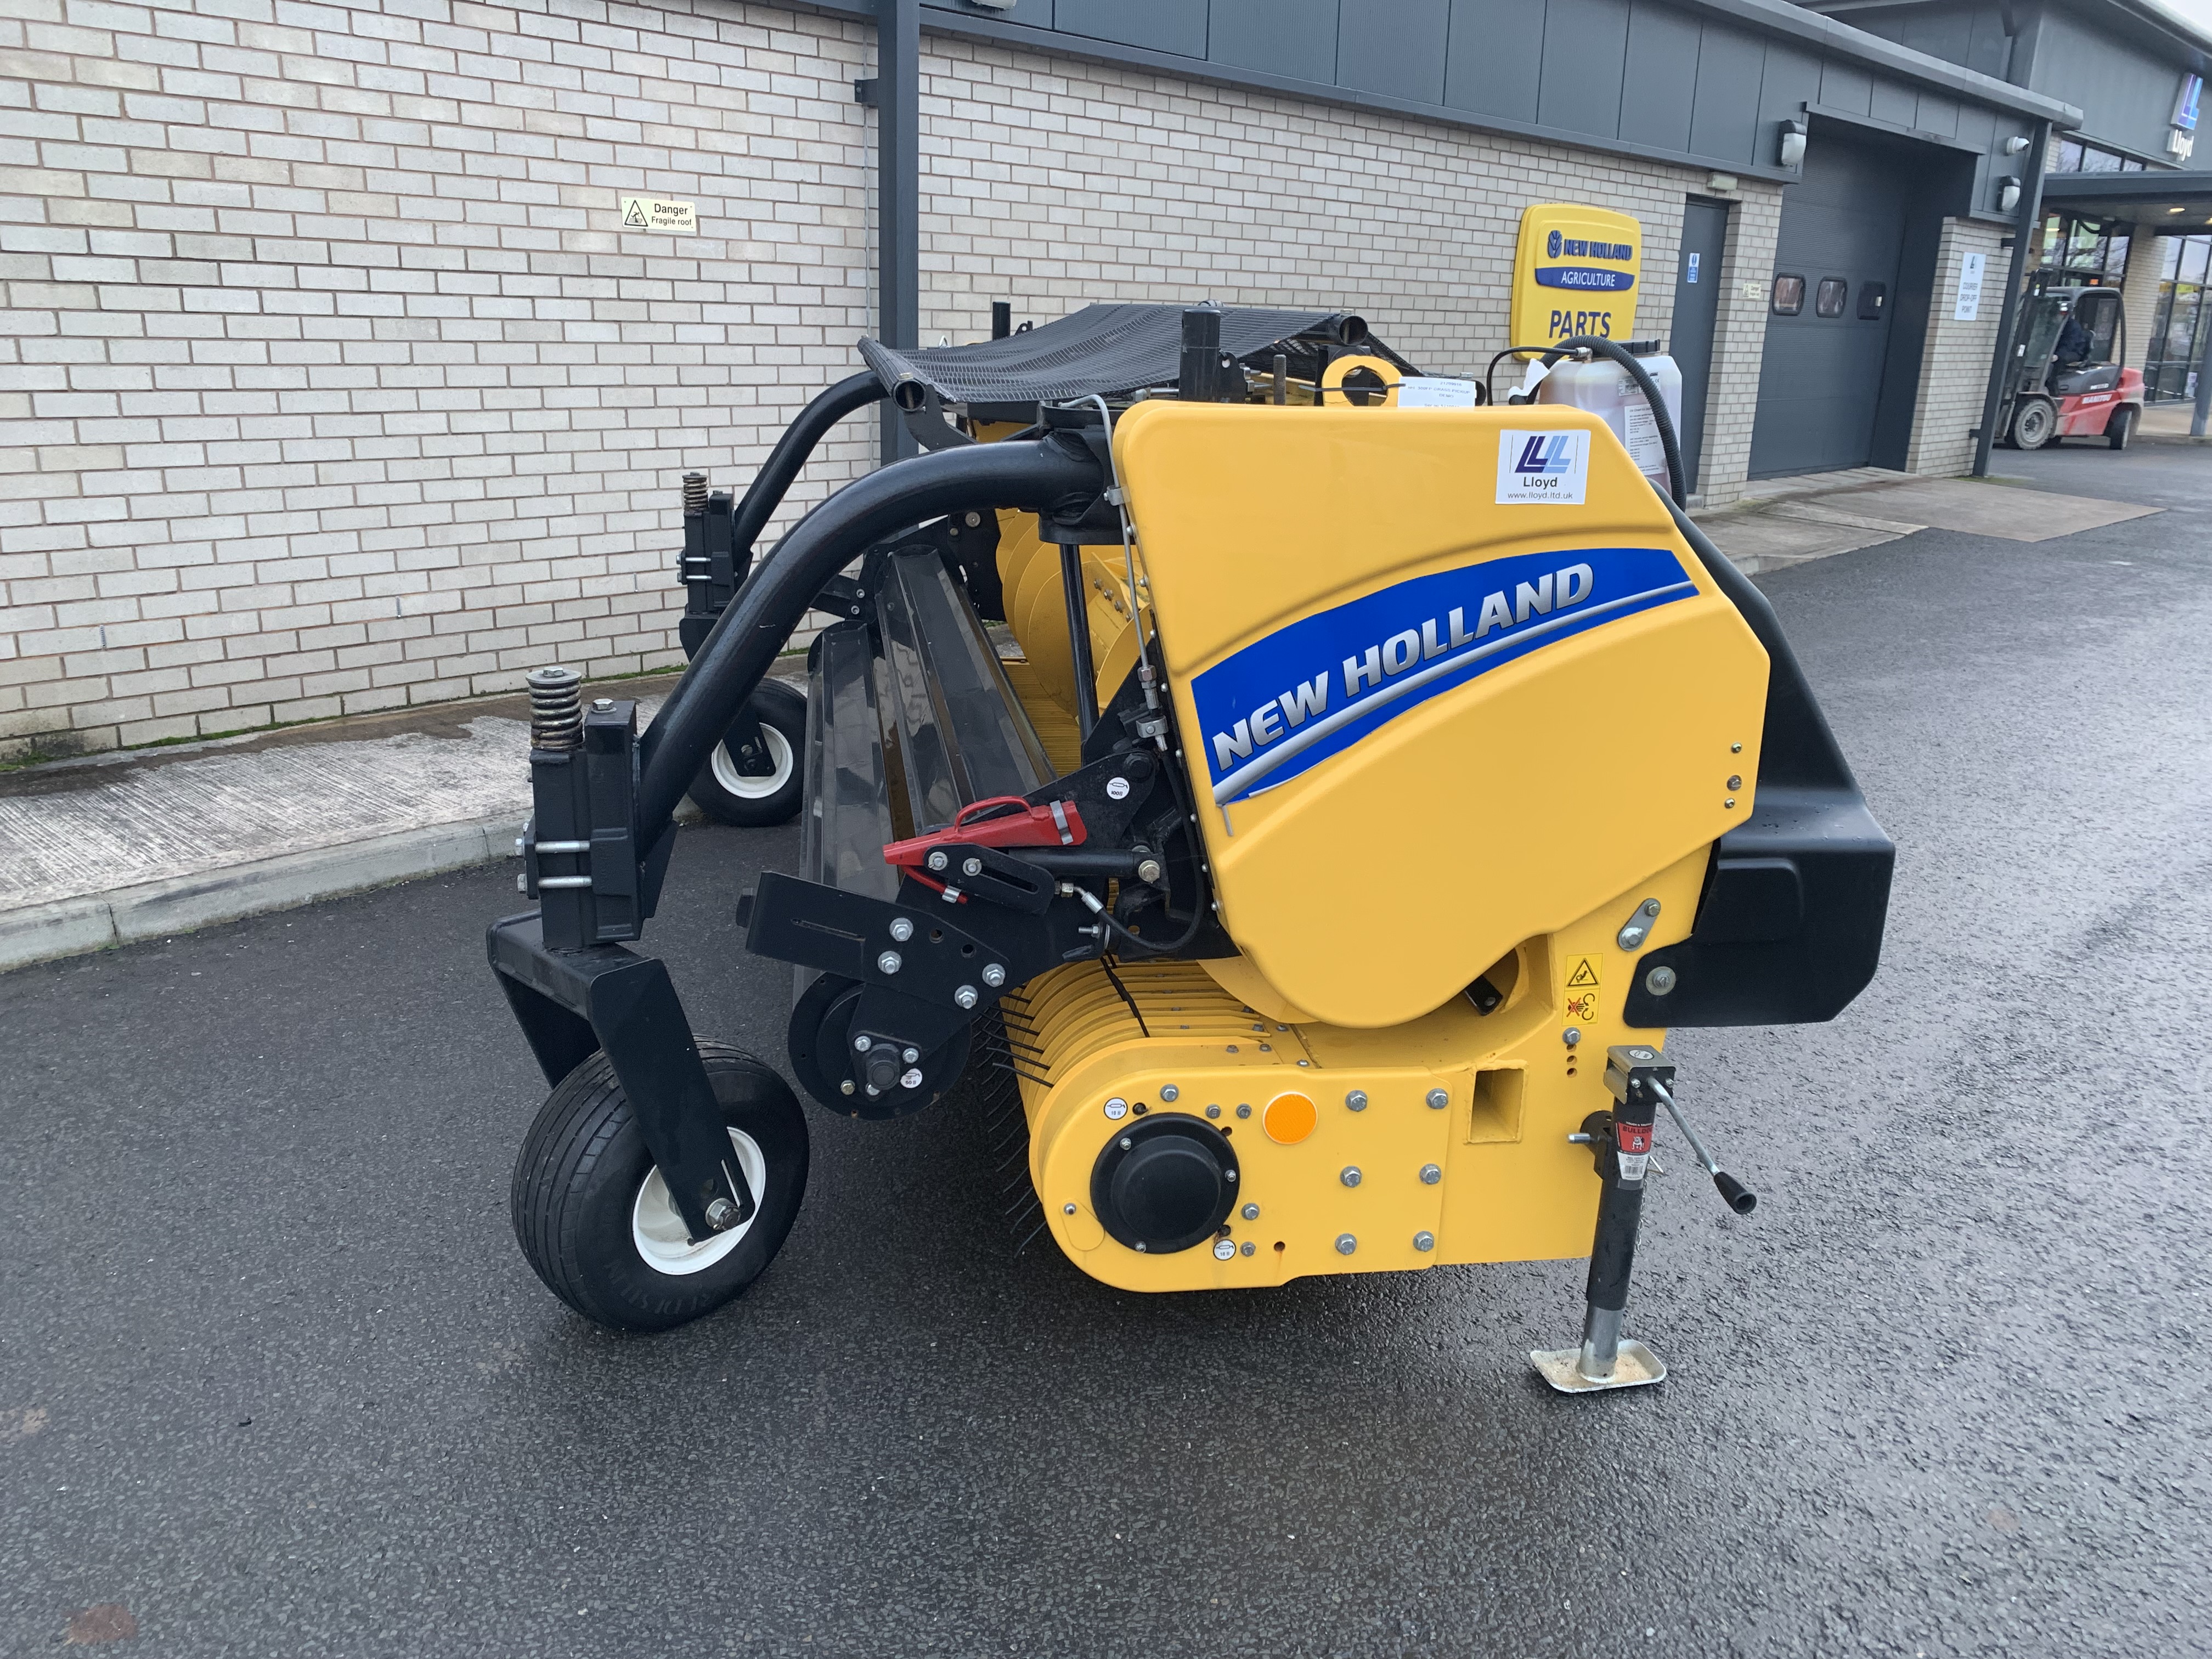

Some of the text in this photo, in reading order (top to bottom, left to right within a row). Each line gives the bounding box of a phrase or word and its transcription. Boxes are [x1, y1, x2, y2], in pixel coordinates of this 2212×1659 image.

[2172, 129, 2194, 161] Lloyd
[654, 204, 688, 216] Danger
[651, 216, 675, 226] Fragile
[1564, 239, 1633, 261] NEW HOLLAND
[1561, 271, 1616, 287] AGRICULTURE
[1549, 310, 1612, 339] PARTS
[1523, 476, 1558, 490] Lloyd
[1508, 492, 1573, 500] www.lloyd.ltd.uk
[1212, 562, 1595, 771] NEW HOLLAND
